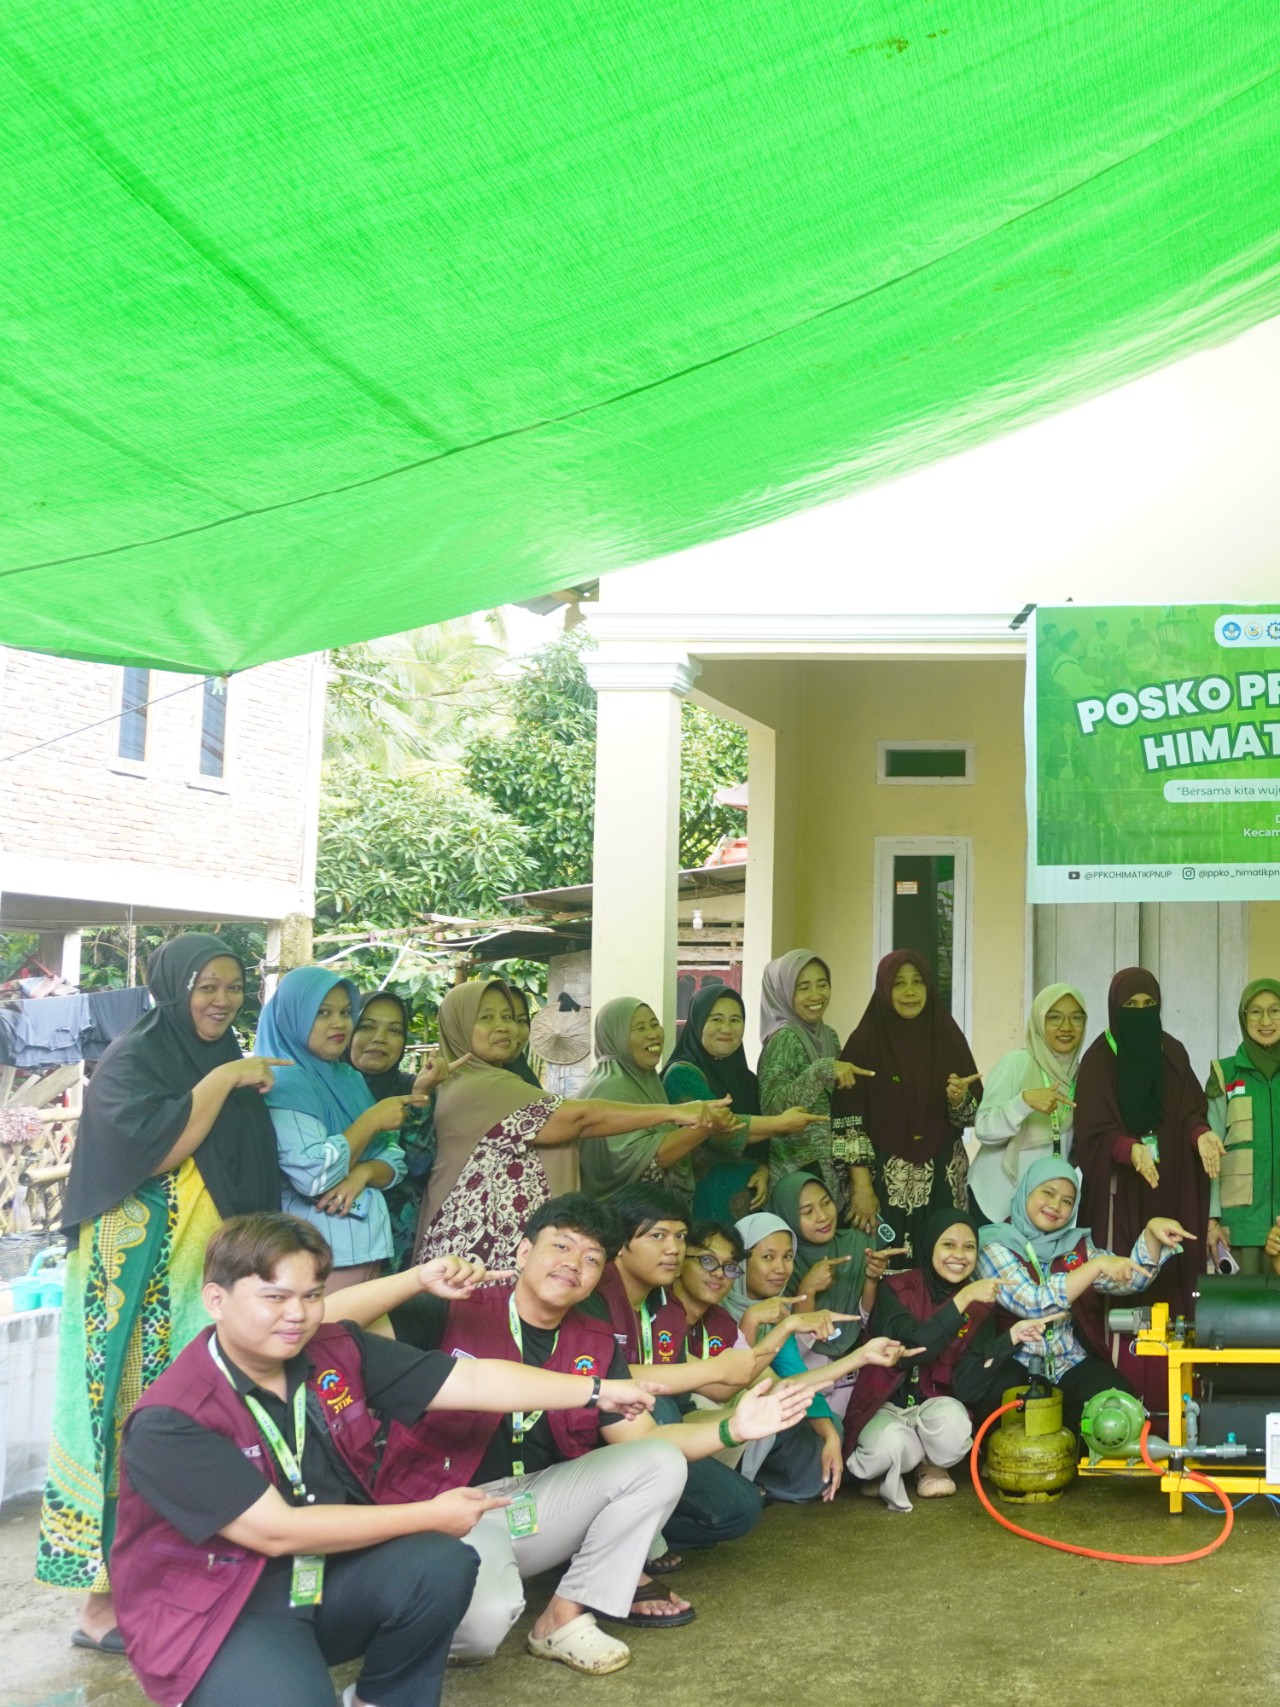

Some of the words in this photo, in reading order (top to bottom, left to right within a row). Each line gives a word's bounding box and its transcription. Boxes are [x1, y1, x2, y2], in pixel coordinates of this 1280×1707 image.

[1076, 676, 1232, 735] POSKO
[1234, 785, 1255, 795] kita
[1084, 870, 1173, 881] @PPKOHIMATIKPNUP
[333, 1395, 354, 1414] JTIK
